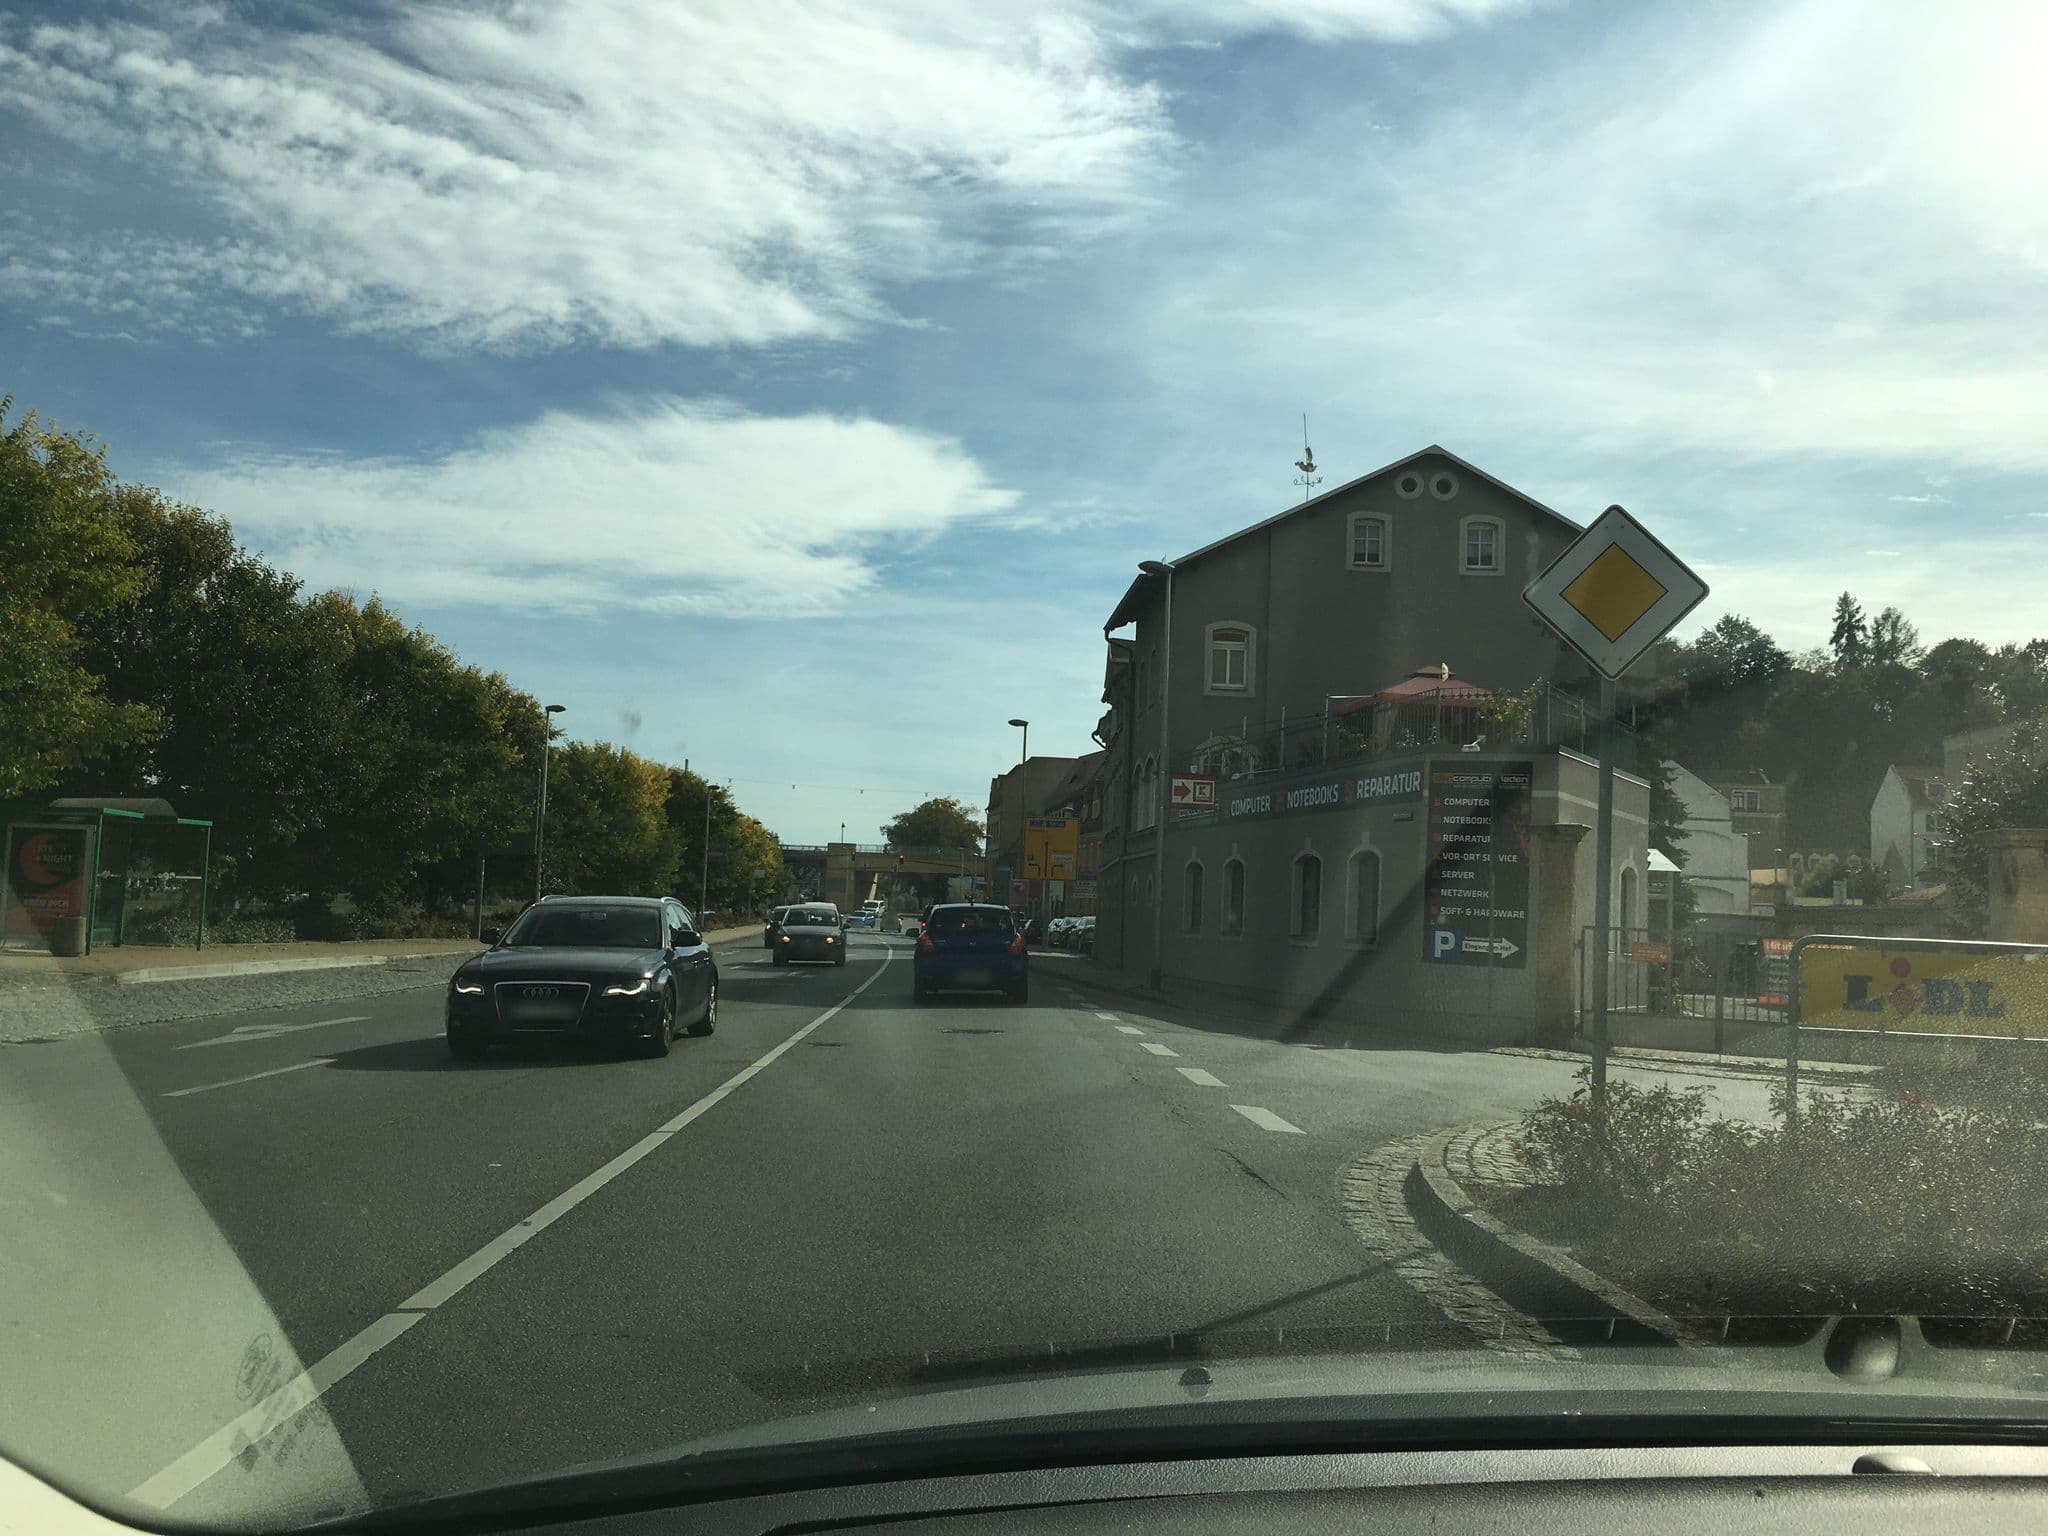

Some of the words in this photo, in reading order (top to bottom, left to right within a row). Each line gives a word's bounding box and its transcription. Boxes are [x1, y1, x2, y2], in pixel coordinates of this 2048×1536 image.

[1231, 795, 1271, 816] COMPUTER
[1286, 784, 1339, 808] NOTEBOOKS
[1356, 771, 1421, 799] REPARATUR
[1443, 798, 1490, 806] COMPUTER
[1442, 852, 1480, 861] VOR-ORT
[1440, 870, 1475, 879] SERVER
[1440, 888, 1489, 898] NETZWERK
[1433, 930, 1456, 958] P
